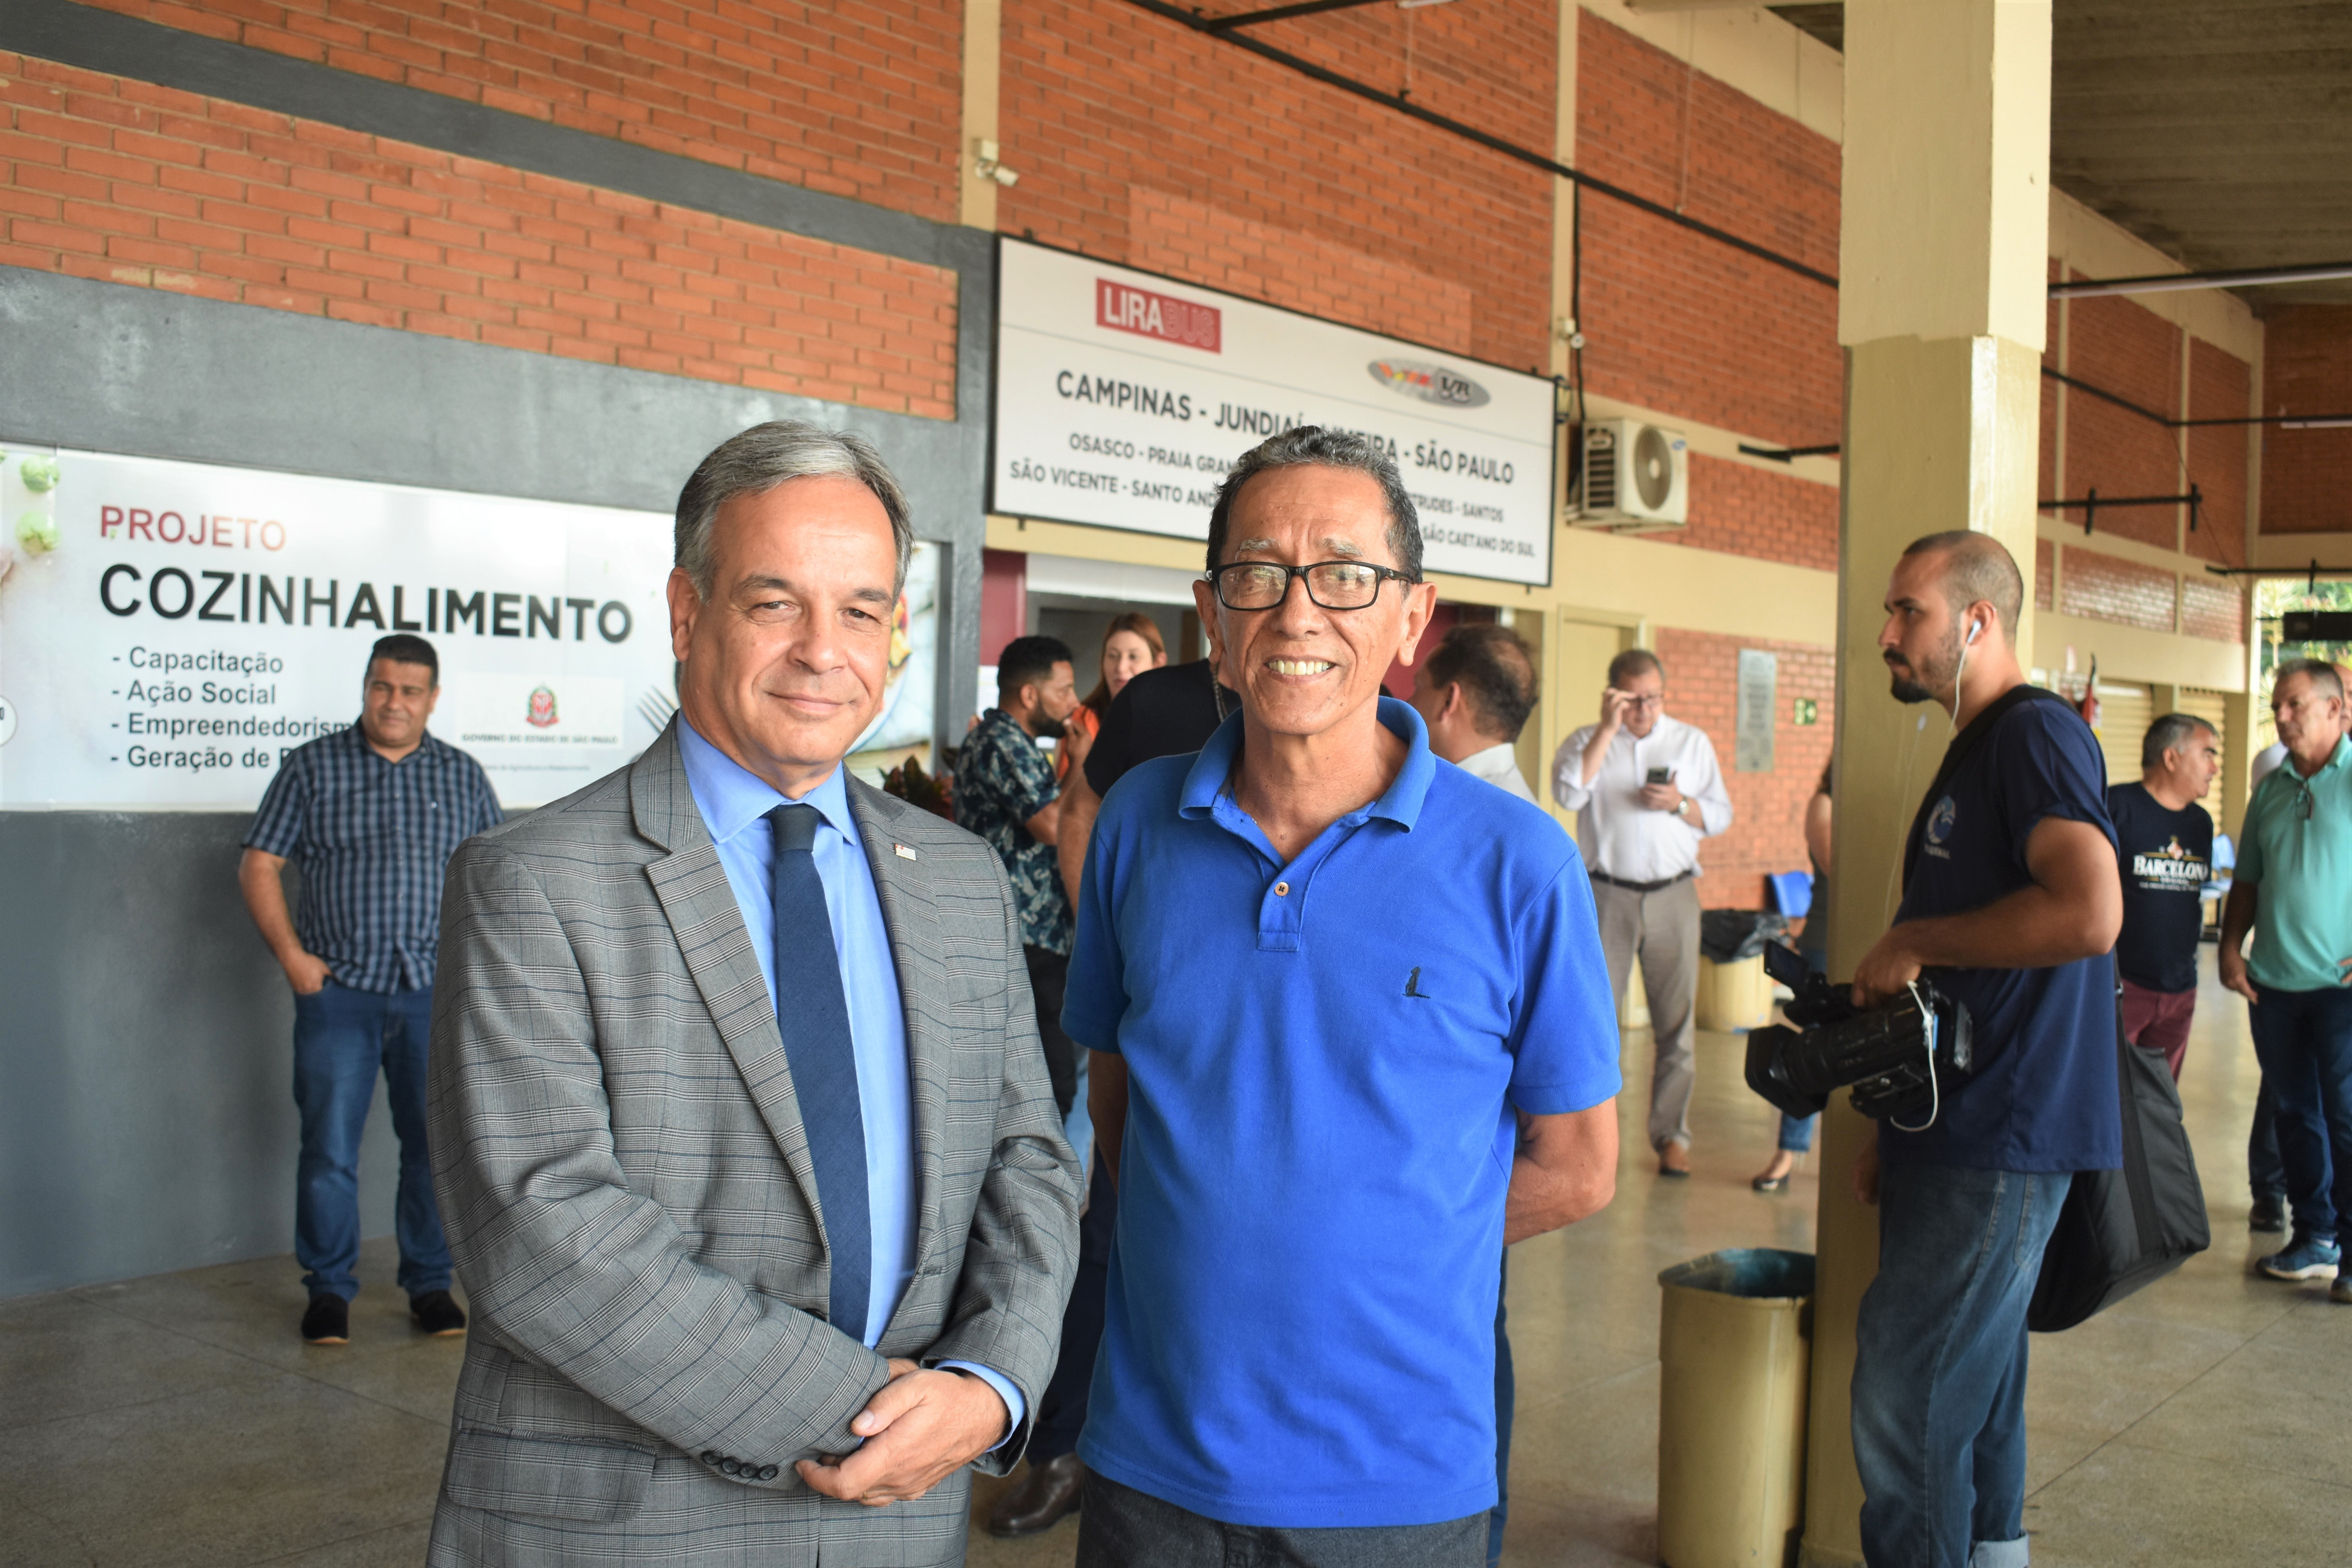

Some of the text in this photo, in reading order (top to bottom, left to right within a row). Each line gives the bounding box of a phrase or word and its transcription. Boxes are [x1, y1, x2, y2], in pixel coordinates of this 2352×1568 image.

[1104, 285, 1215, 347] LIRABUS
[1057, 370, 1191, 421] CAMPINAS
[1069, 433, 1134, 459] OSASCO
[1148, 446, 1192, 469] PRAIA
[1416, 439, 1452, 471] SÃO
[1457, 452, 1514, 484] PAULO
[1010, 457, 1045, 482] SÃO
[1051, 466, 1118, 494] VICENTE
[1132, 480, 1183, 502] SANTO
[1187, 490, 1216, 507] AND
[1408, 494, 1453, 514] TRUDES
[1463, 502, 1504, 523] SANTOS
[101, 505, 287, 551] PROJETO
[1422, 522, 1535, 557] SÃO CAETANO DO SUL
[100, 563, 633, 643] COZINHALIMENTO
[130, 646, 283, 677] Capacitação
[127, 680, 192, 706] Ação
[202, 681, 276, 704] Social
[129, 712, 355, 740] Empreendedorism
[463, 734, 505, 742] GOVERNO
[128, 745, 233, 773] Geração
[243, 748, 270, 767] de
